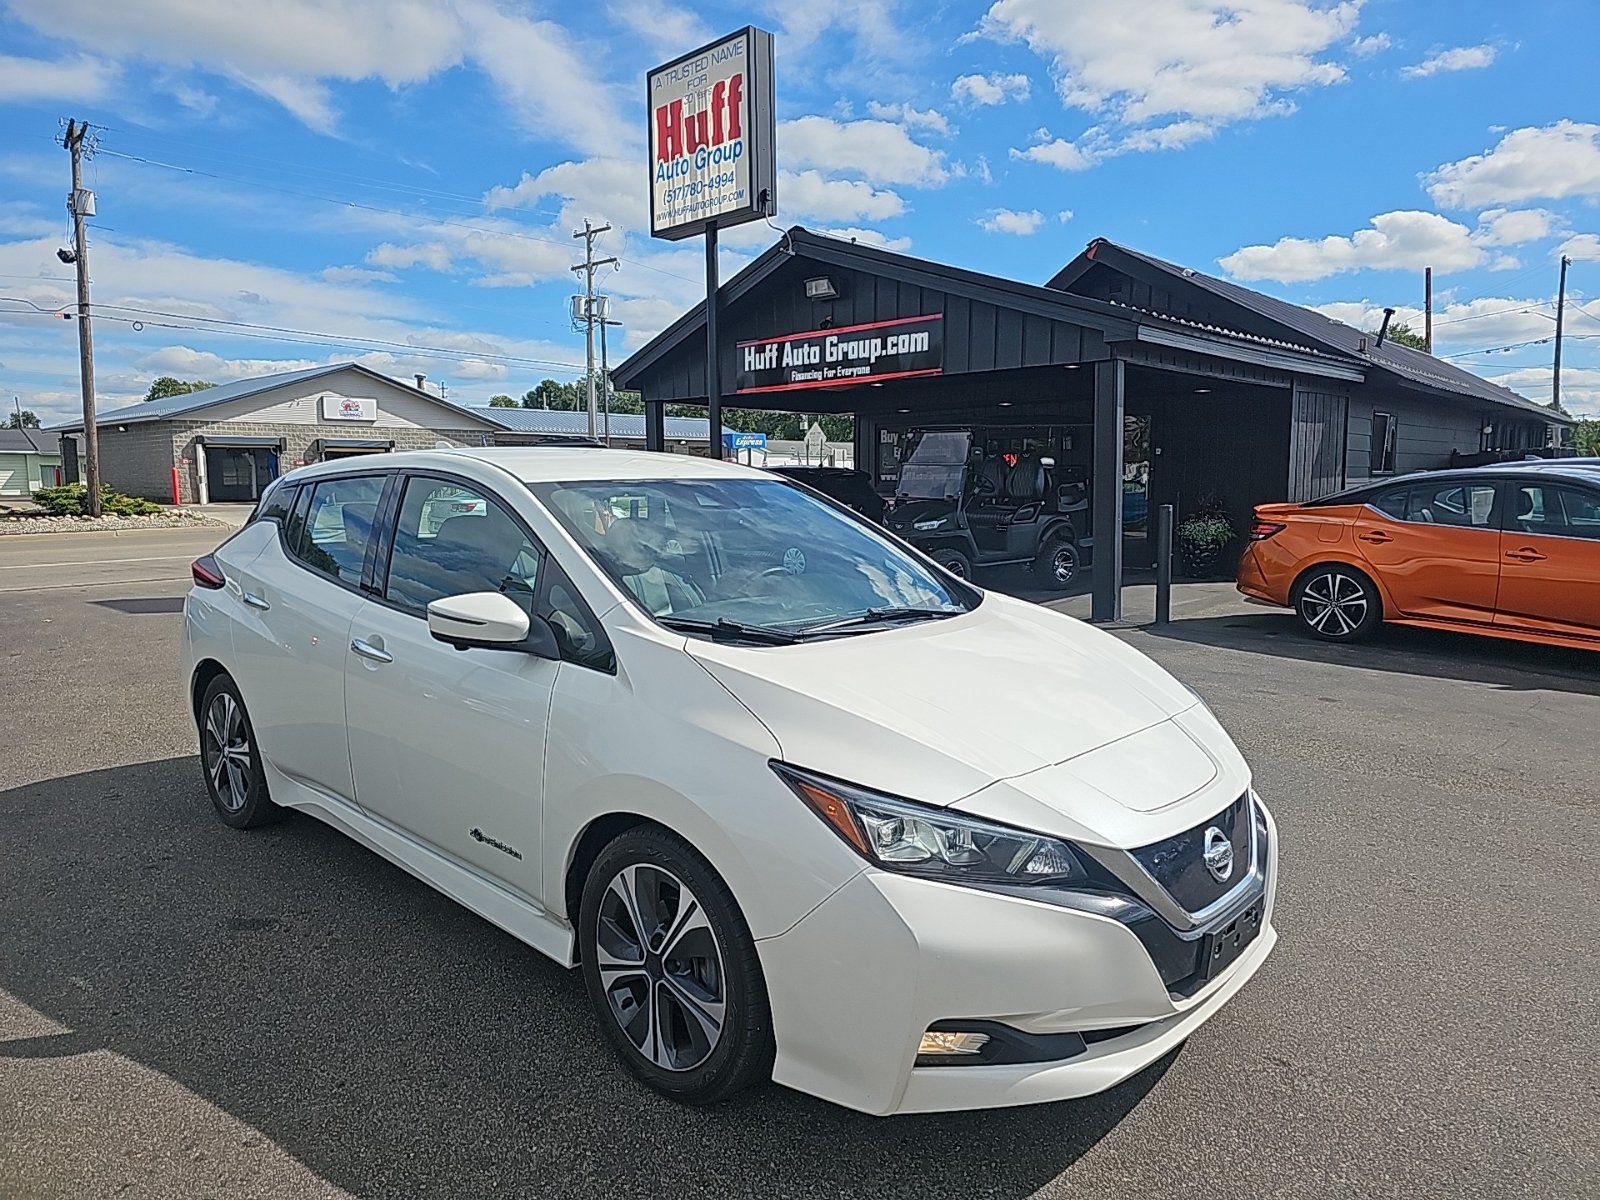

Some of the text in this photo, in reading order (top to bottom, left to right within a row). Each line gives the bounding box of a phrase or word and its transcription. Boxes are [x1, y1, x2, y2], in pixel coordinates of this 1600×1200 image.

[655, 40, 743, 90] A TRUSTED NAME
[687, 74, 707, 90] FOR
[656, 73, 743, 163] Huff
[656, 140, 743, 183] Auto Group
[656, 189, 745, 222] WWW.HUFFAUTOGROUP.COM
[663, 171, 735, 206] (517)780-4994
[744, 331, 929, 372] Huff Auto Group.com
[791, 365, 871, 382] Financing For Everyone
[735, 437, 763, 447] Express
[881, 430, 899, 445] Buy
